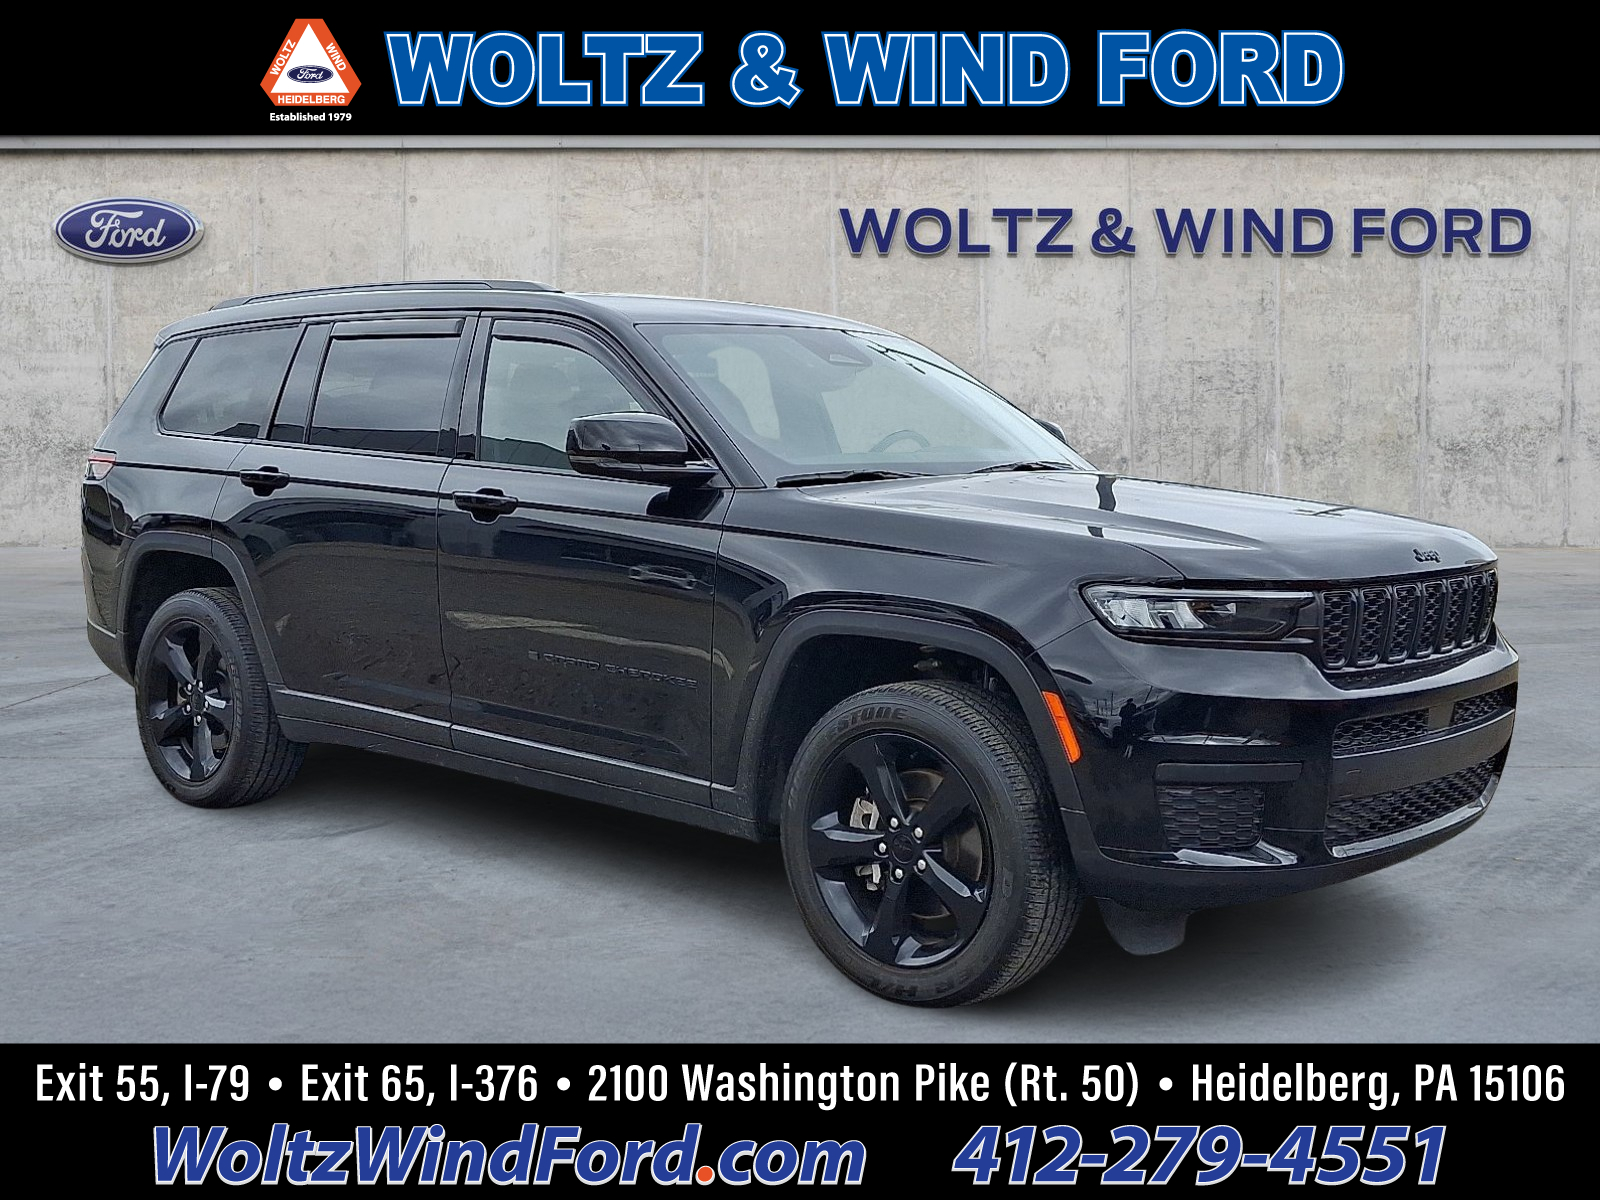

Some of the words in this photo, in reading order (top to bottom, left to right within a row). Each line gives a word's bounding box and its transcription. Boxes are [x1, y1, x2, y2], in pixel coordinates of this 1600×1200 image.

[85, 209, 167, 249] Ford
[841, 208, 1073, 254] WOLTZ
[1091, 208, 1136, 254] &
[1156, 208, 1334, 254] WIND
[1353, 208, 1533, 254] FORD
